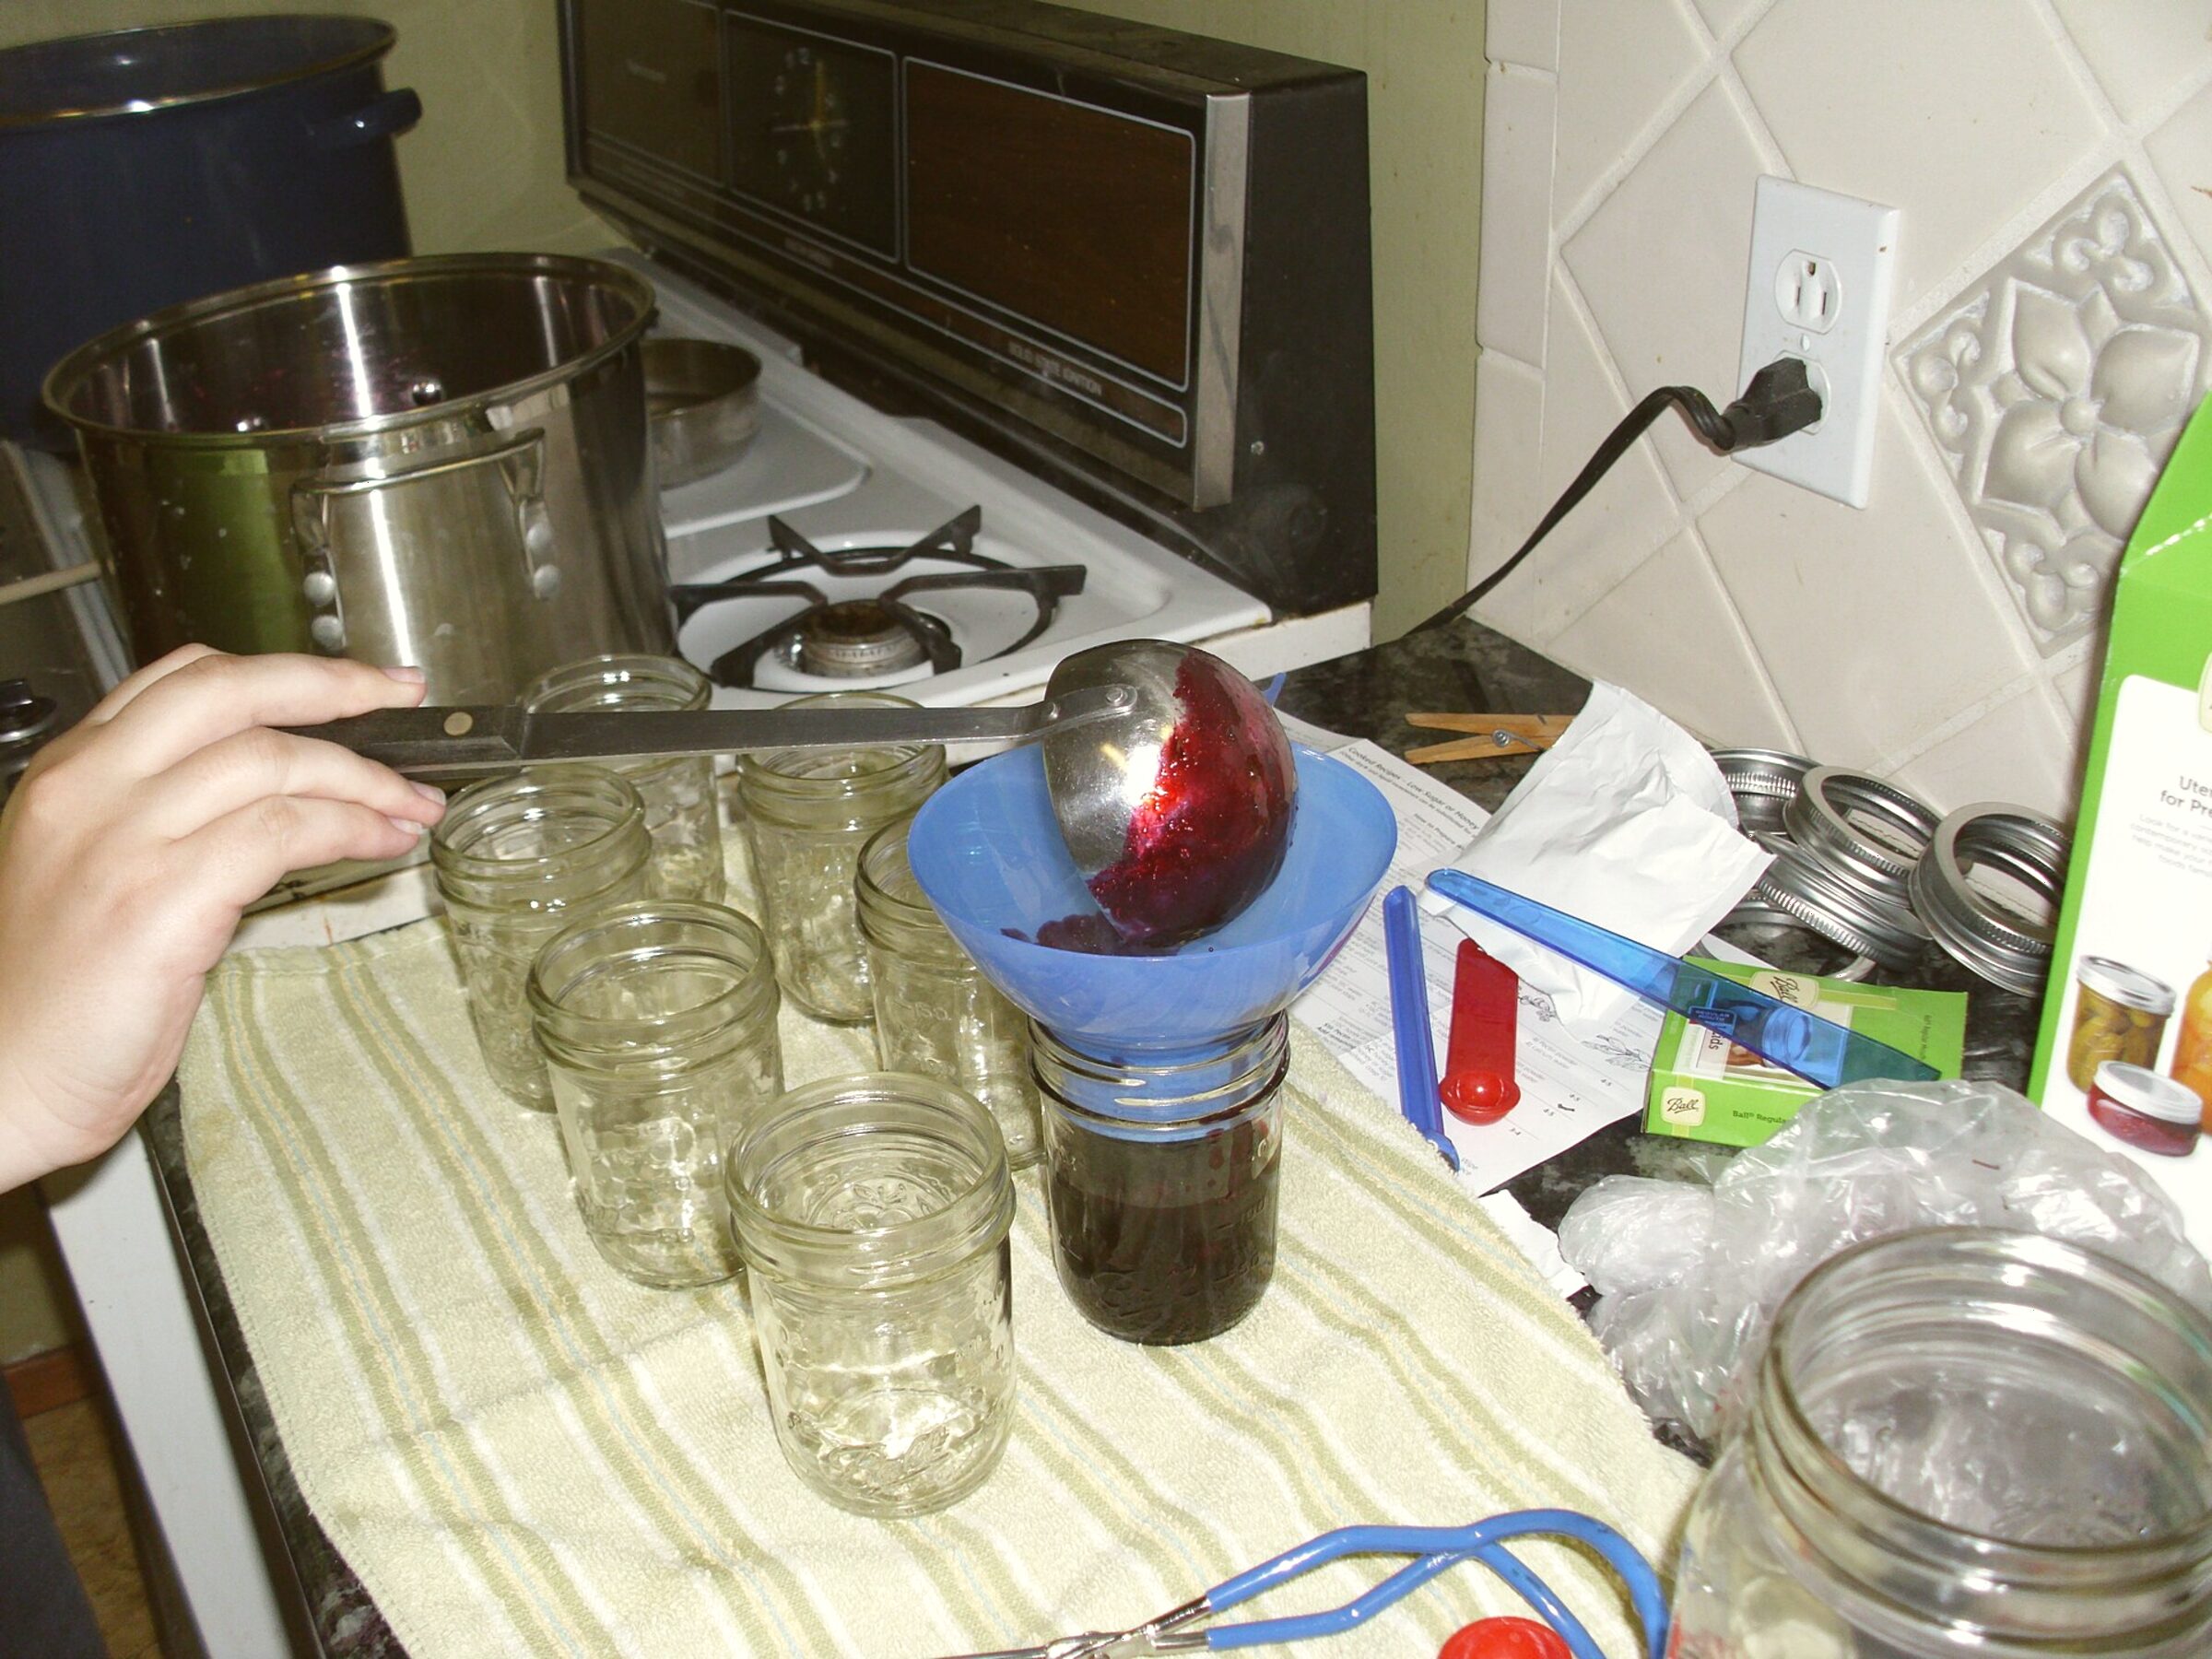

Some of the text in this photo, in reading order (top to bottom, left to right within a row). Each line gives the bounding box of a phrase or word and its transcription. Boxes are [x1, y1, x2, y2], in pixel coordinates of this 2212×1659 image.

[1348, 747, 1375, 766] Cooked
[1375, 762, 1401, 781] Recipes
[1423, 791, 1446, 810] Sugar
[1455, 809, 1479, 830] Honey
[2160, 789, 2185, 808] for
[1666, 1097, 1700, 1114] Ball
[1756, 1113, 1787, 1124] Regula
